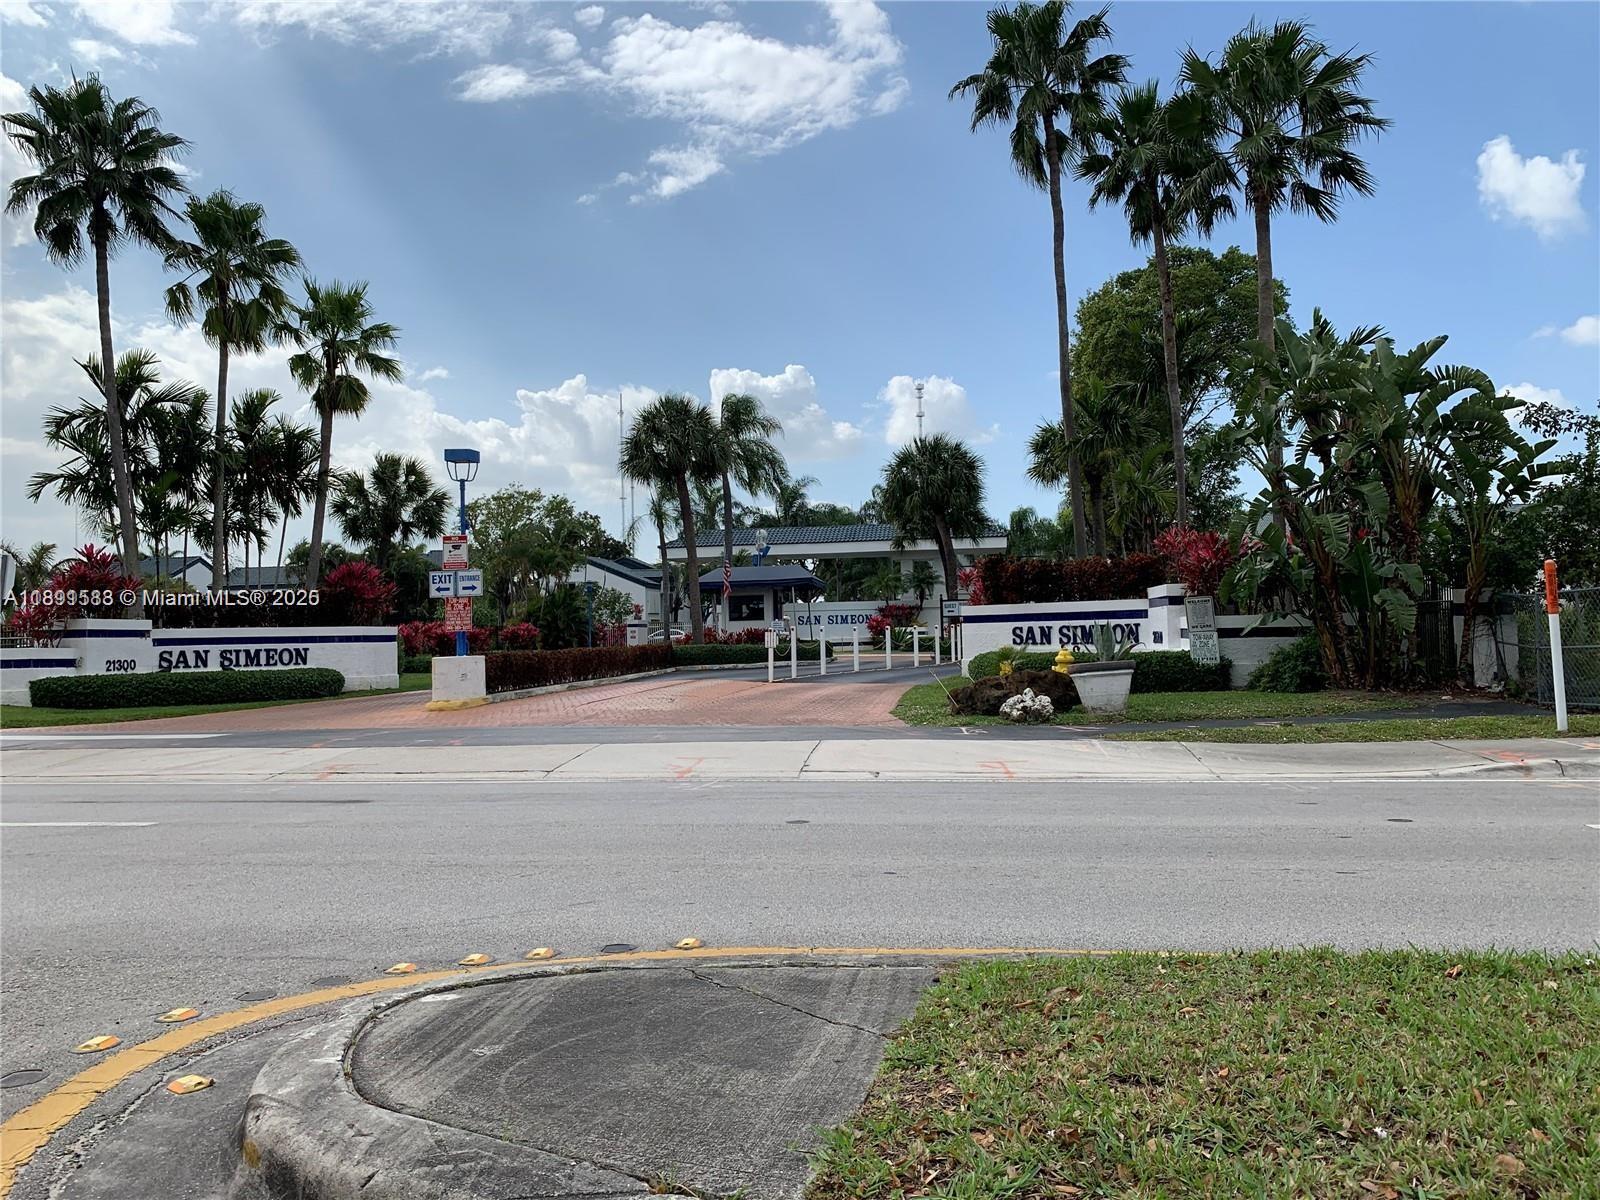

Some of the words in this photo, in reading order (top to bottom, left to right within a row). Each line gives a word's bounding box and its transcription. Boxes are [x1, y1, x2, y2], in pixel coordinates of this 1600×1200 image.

[432, 574, 453, 585] EXIT
[459, 574, 481, 582] ENTRANCE
[797, 615, 822, 626] SAN
[827, 613, 873, 625] SIMEON
[1011, 625, 1053, 646] SAN
[158, 649, 211, 670] SAN
[219, 647, 310, 670] SIMEON
[105, 659, 137, 672] 21300
